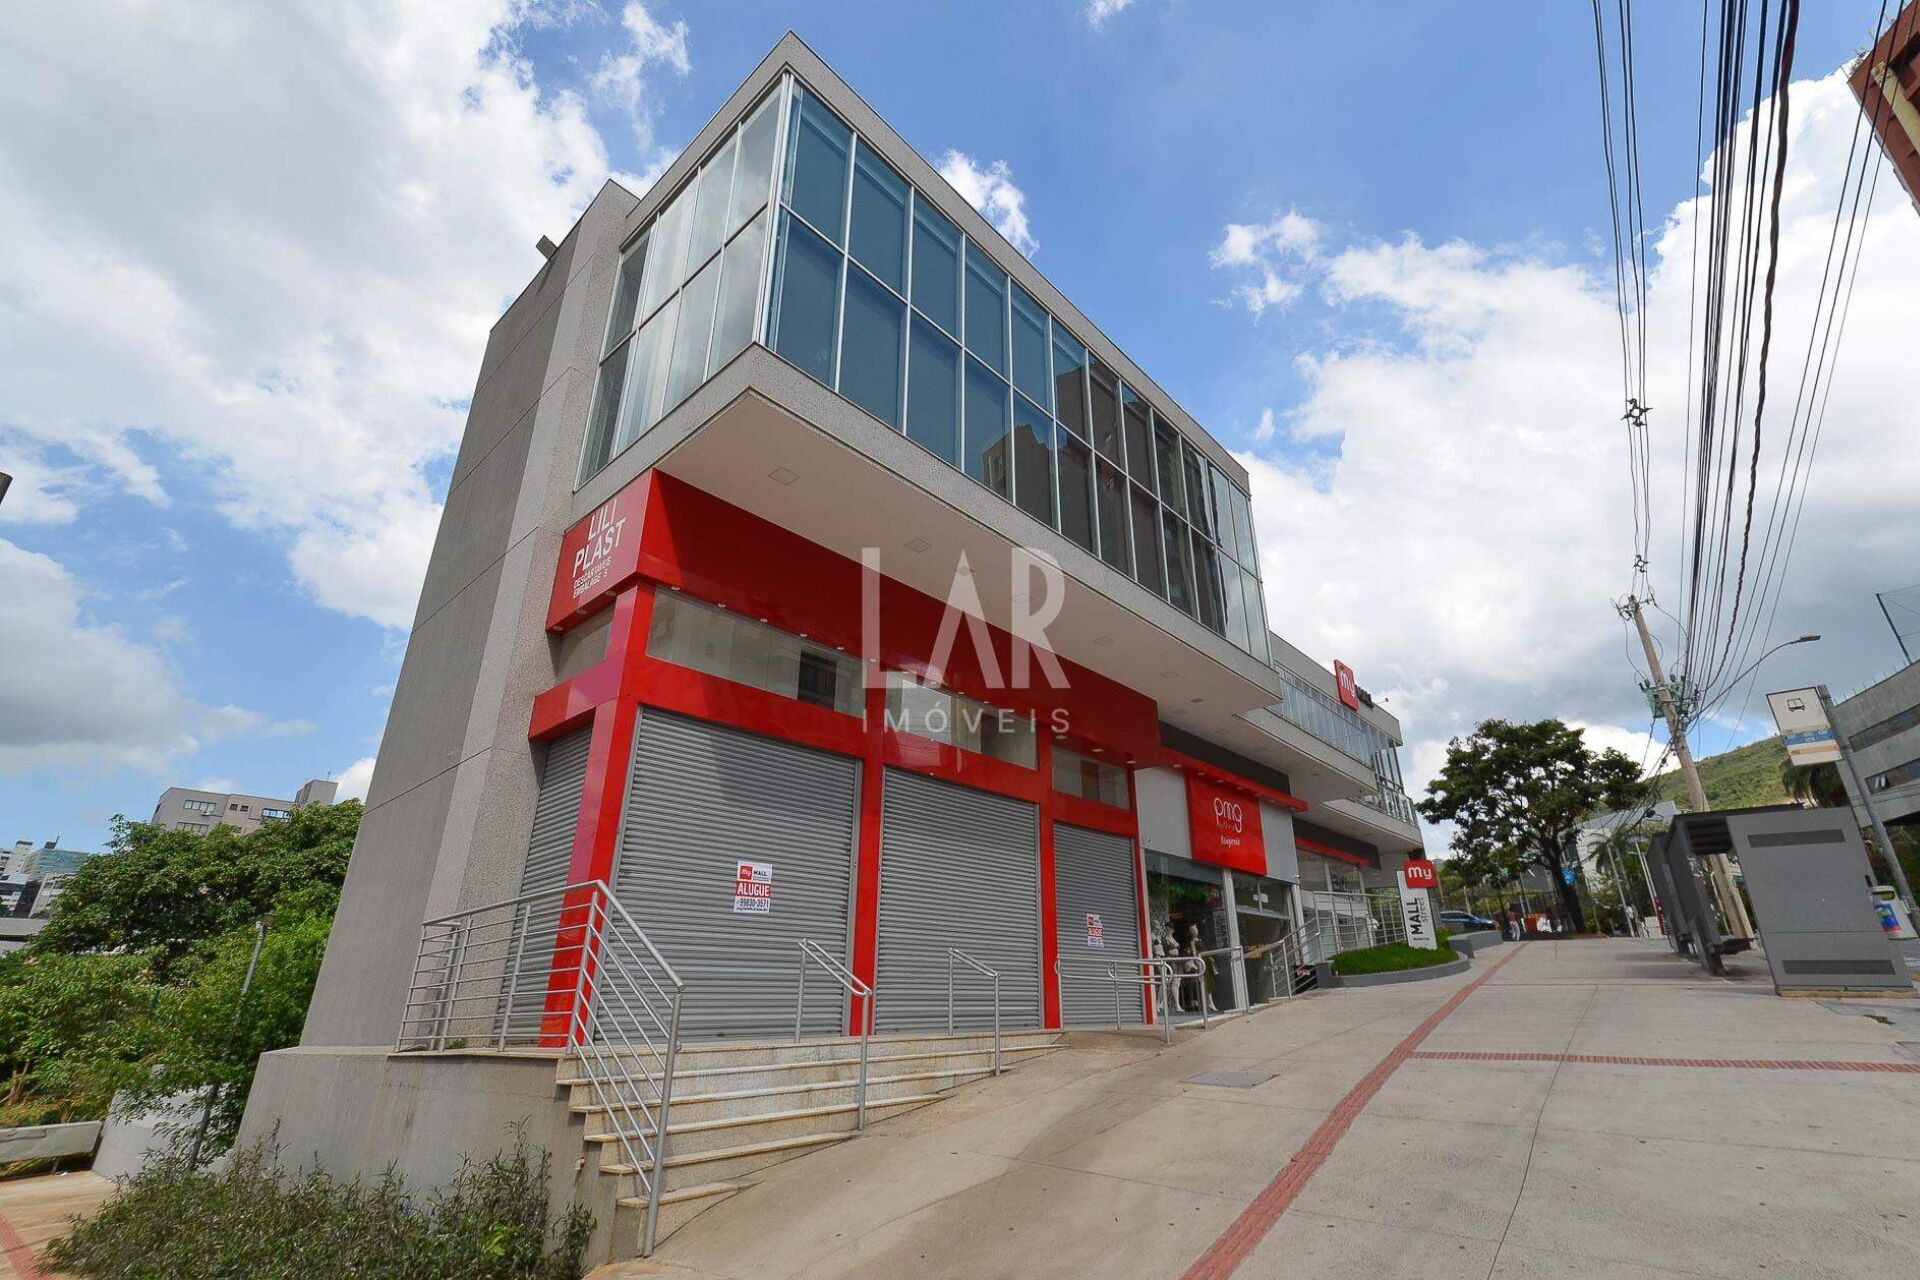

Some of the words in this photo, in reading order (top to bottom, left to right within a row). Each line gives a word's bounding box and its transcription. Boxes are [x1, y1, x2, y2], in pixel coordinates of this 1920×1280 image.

[588, 498, 618, 541] LILI
[572, 517, 627, 578] PLAST
[1213, 797, 1242, 833] pmg
[737, 882, 770, 897] ALUGUE
[1406, 897, 1424, 935] MALL
